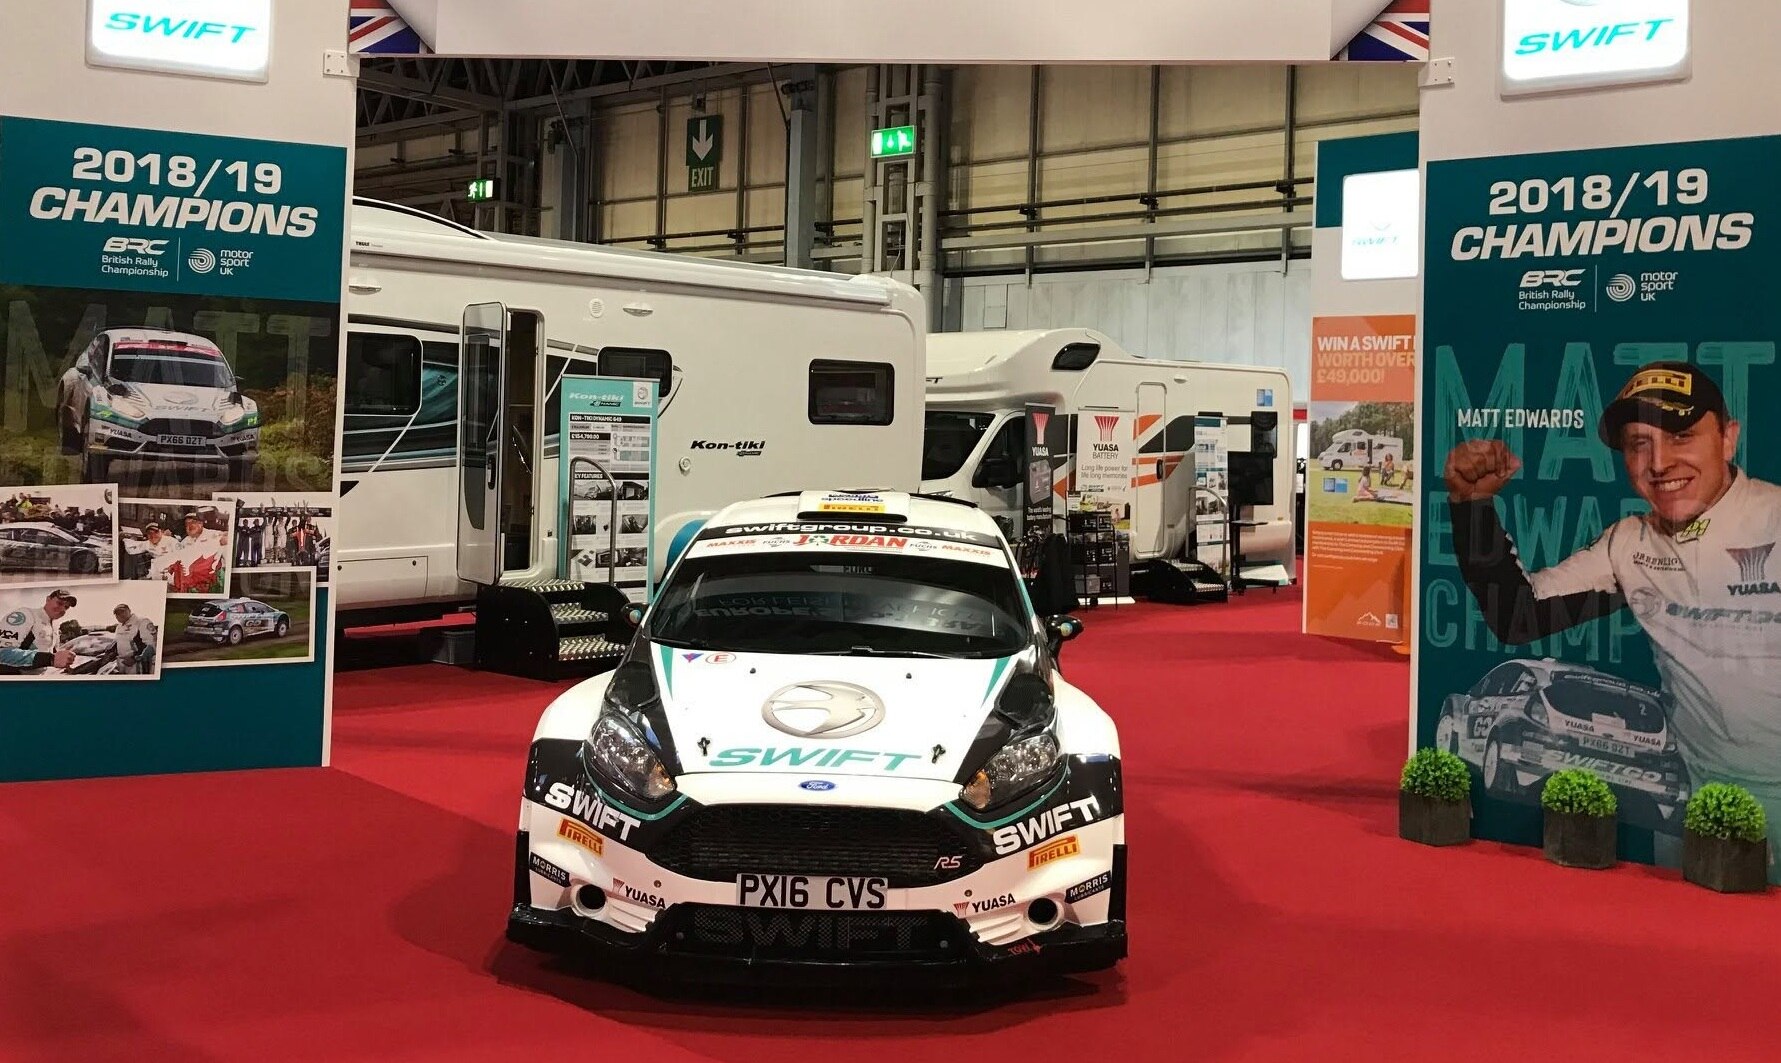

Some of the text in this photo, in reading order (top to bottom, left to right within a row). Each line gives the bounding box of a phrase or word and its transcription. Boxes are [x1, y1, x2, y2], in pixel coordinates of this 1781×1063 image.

[105, 12, 256, 43] SWIFT
[1514, 18, 1674, 55] SWIFT
[72, 147, 282, 197] 2018/19
[691, 166, 714, 188] EXIT
[1489, 168, 1709, 218] 2018/19
[29, 187, 318, 238] CHAMPIONS
[1450, 213, 1754, 261] CHAMPIONS
[103, 237, 169, 256] BRC
[220, 249, 254, 260] motor
[101, 255, 159, 268] British Rally
[220, 258, 250, 268] sport
[101, 265, 169, 278] Championship
[219, 267, 234, 276] UK
[1519, 269, 1586, 288] BRC
[1640, 271, 1678, 281] motor
[1640, 279, 1675, 292] sport
[1518, 289, 1575, 302] British Rally
[1640, 291, 1656, 302] UK
[1518, 299, 1586, 312] Championship
[1317, 336, 1348, 351] WIN
[1350, 336, 1360, 351] A
[1362, 335, 1411, 350] SWIFT
[1317, 352, 1373, 368] WORTH
[1316, 368, 1385, 386] £49,000!
[568, 392, 624, 400] Kon-tiki
[1457, 408, 1584, 429] MATT EDWARDS
[690, 440, 766, 450] Kon-tiki
[1032, 446, 1049, 456] YUASA
[1093, 443, 1119, 451] YUASA
[1089, 472, 1101, 480] long
[726, 523, 977, 541] swiftgroup.co.uk
[707, 539, 756, 548] MAXXIS
[942, 545, 991, 556] MAXXIS
[1727, 582, 1781, 596] YUASA
[1639, 703, 1647, 716] 2
[1565, 720, 1595, 732] YUASA
[1633, 735, 1661, 746] YUASA
[709, 748, 922, 771] SWIFT
[806, 781, 830, 791] Ford
[544, 781, 641, 841] SWIFT
[992, 794, 1100, 855] SWIFT
[559, 819, 603, 853] PIRELLI
[1028, 835, 1077, 869] PIRELLI
[532, 856, 567, 881] MORRIS
[934, 855, 963, 870] RS
[740, 874, 888, 909] PX16 CVS
[1070, 873, 1109, 898] MORRIS
[625, 885, 666, 909] YUASA
[972, 893, 1016, 913] YUASA
[694, 907, 929, 950] SWIFT
